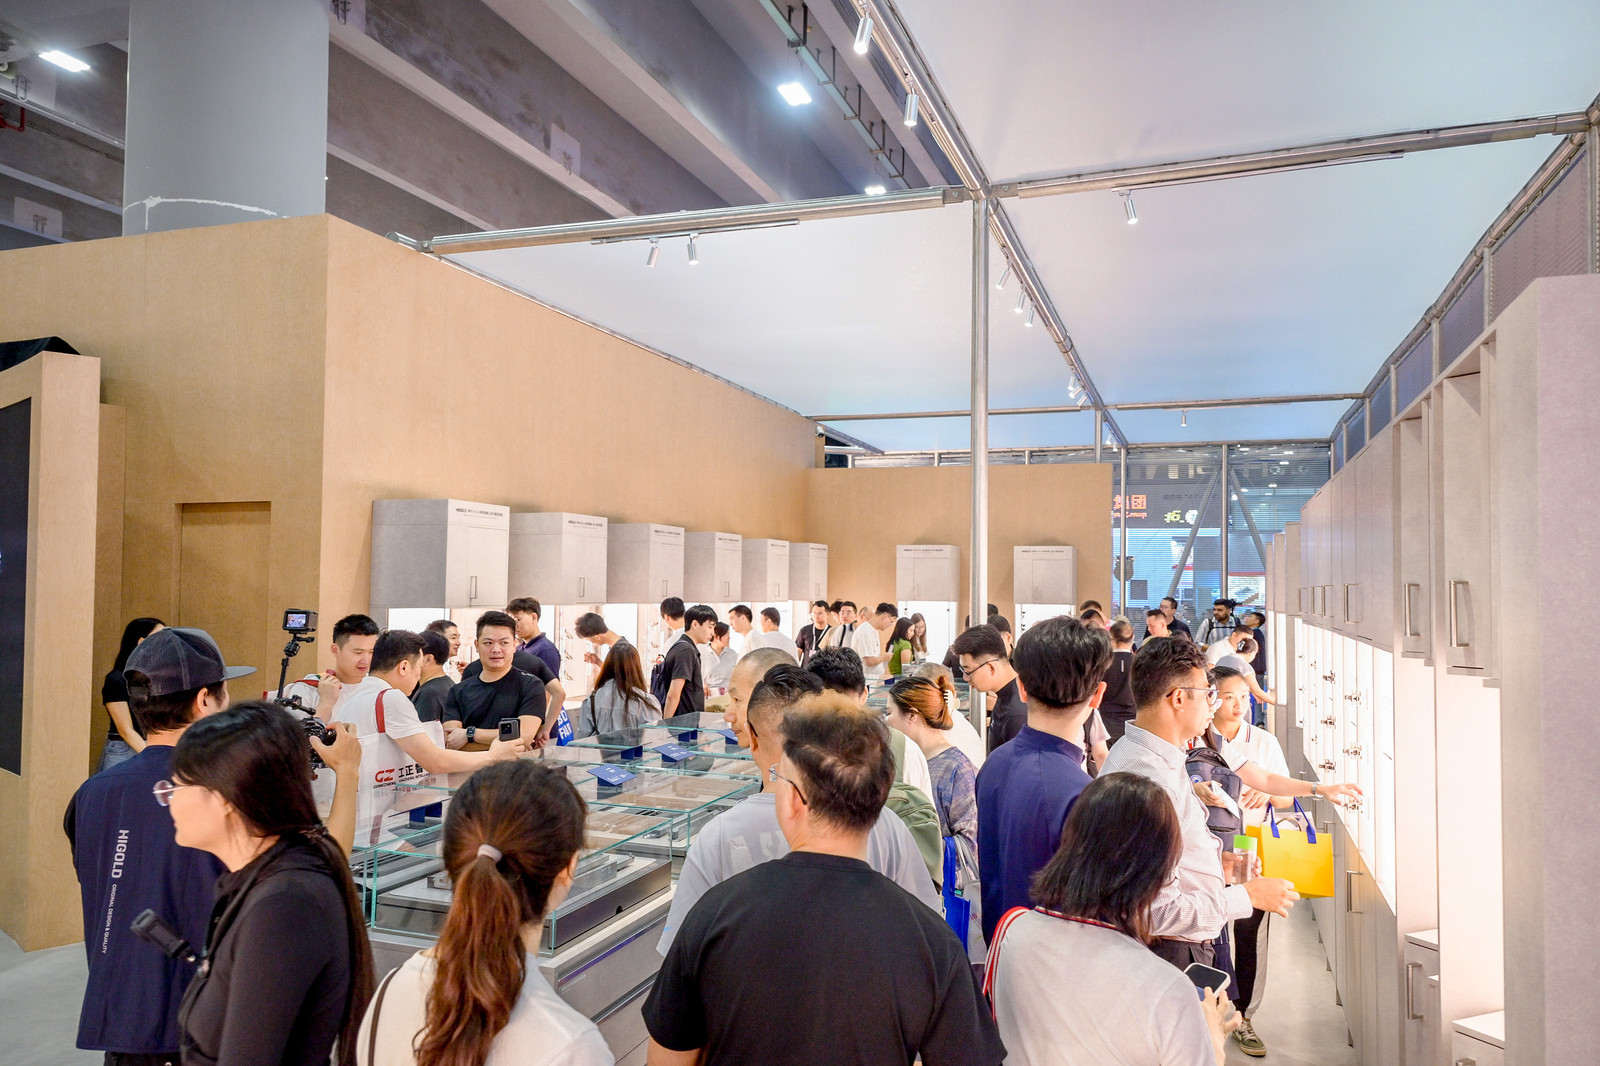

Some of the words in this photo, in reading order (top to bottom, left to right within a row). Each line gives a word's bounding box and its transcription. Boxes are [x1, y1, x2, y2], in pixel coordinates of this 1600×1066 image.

[375, 768, 395, 783] GZ
[112, 829, 130, 879] HIGOLD
[109, 884, 118, 908] ORIGINAL
[106, 908, 114, 928] DESIGN
[102, 931, 110, 954] QUALITY
